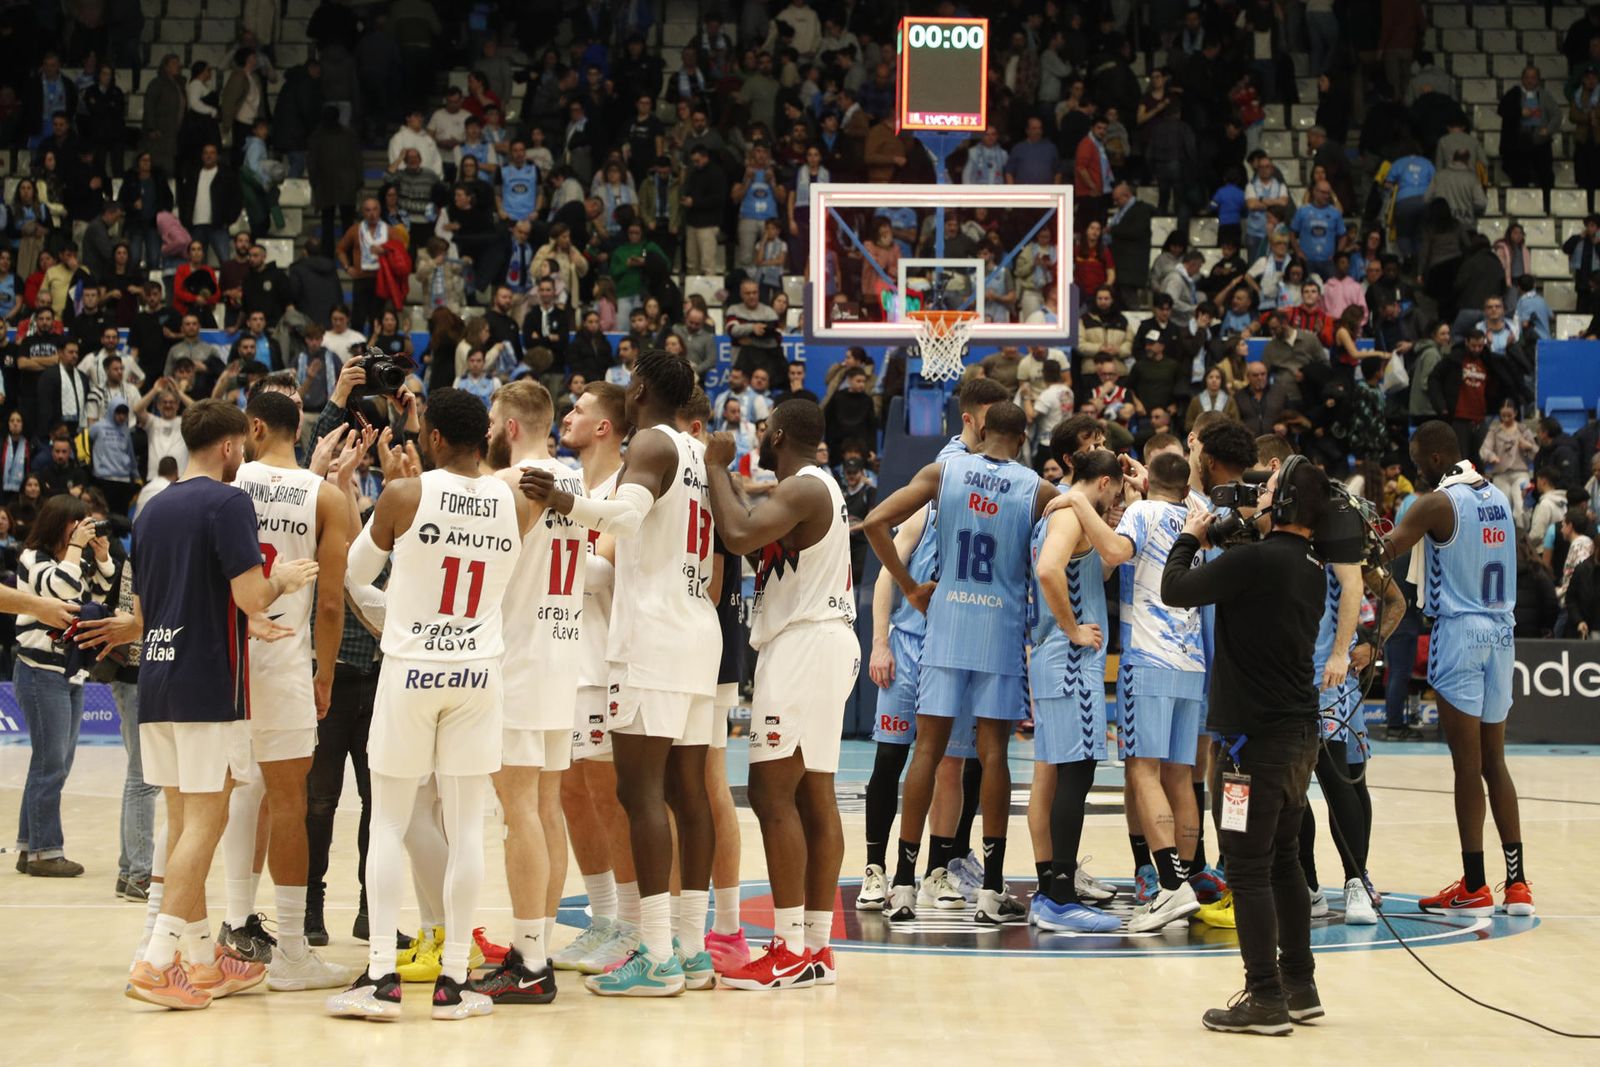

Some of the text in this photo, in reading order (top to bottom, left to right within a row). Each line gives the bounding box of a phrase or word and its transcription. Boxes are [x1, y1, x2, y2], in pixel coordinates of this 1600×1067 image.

[909, 25, 984, 49] 00:00
[964, 471, 1011, 494] SAKHO
[441, 492, 499, 518] FORREST
[968, 492, 998, 515] Río
[257, 518, 308, 536] MUTIO
[1482, 527, 1505, 544] Río
[446, 531, 512, 552] AMUTIO
[548, 538, 580, 595] 17
[956, 528, 997, 585] 18
[438, 556, 486, 618] 11
[948, 590, 1003, 608] ABANCA
[424, 636, 476, 651] álava
[405, 668, 488, 690] Recalvi
[880, 714, 910, 732] Río
